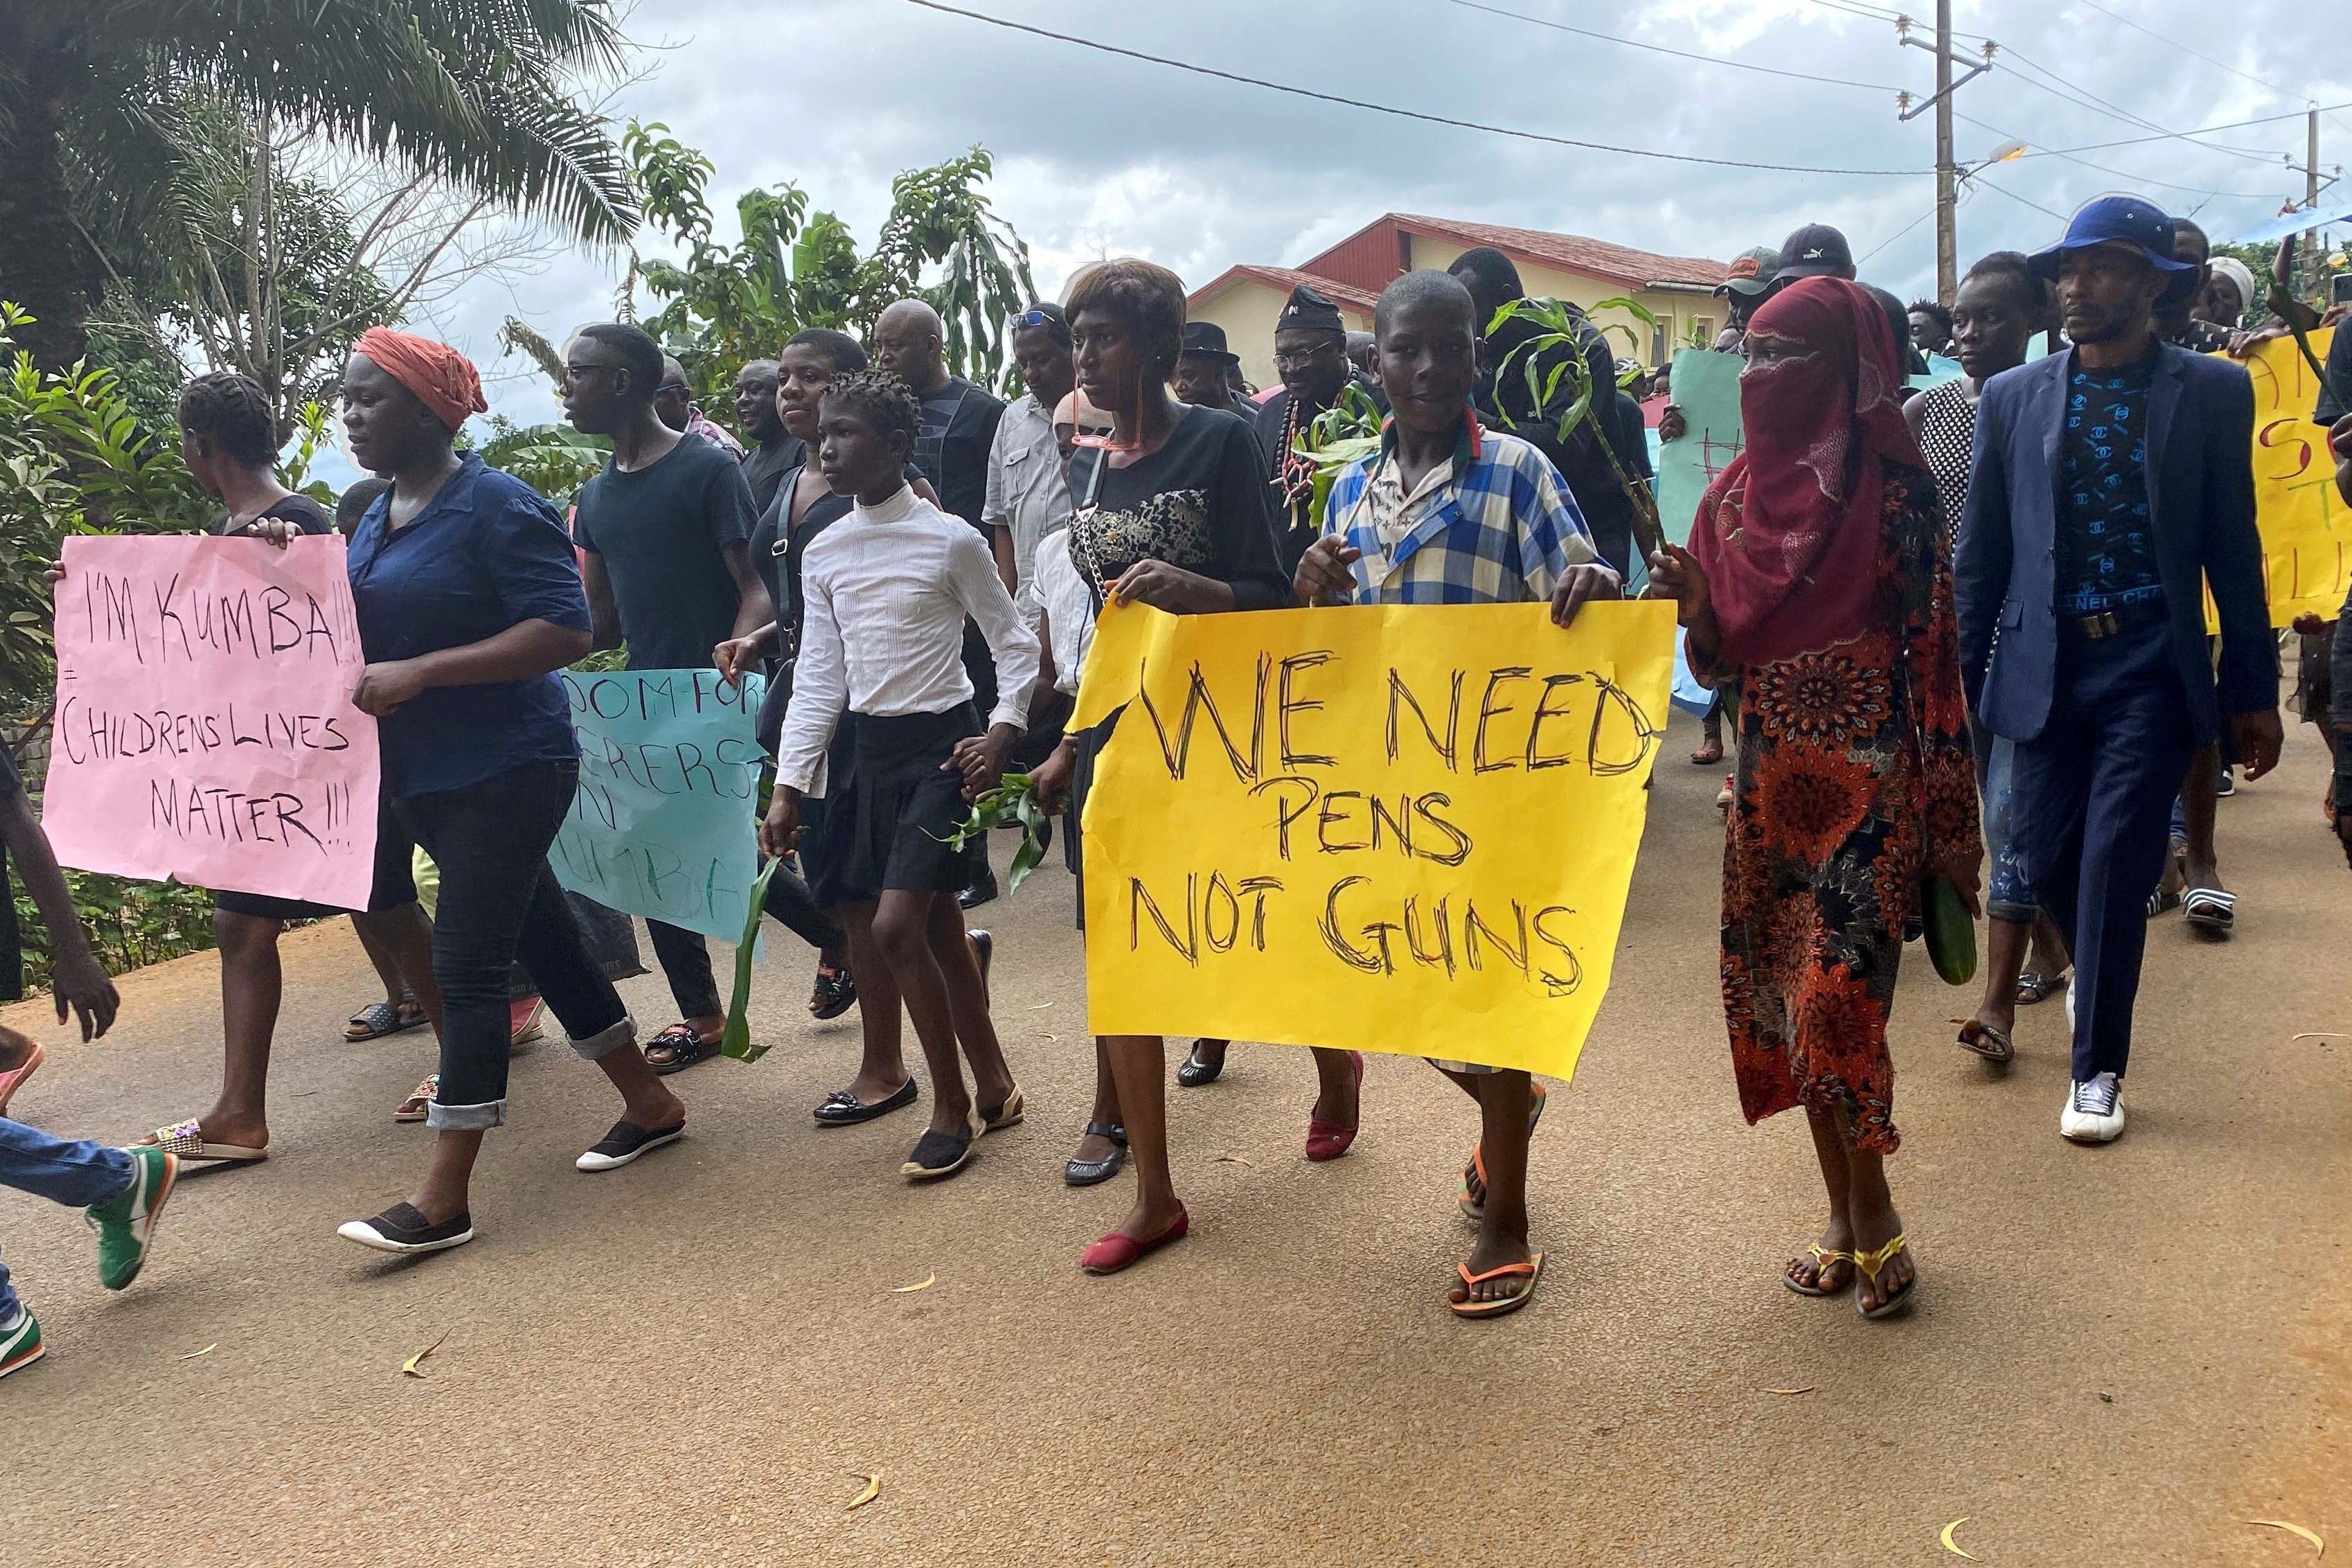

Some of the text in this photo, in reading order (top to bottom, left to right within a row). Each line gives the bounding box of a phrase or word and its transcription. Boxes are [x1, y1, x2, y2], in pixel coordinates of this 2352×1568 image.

[85, 570, 144, 665] I'M
[230, 702, 350, 753] LIVES
[693, 671, 759, 715] FOR
[1141, 648, 1655, 782] WE NEED
[1249, 776, 1475, 867] PENS
[1129, 870, 1584, 999] NOT GUNS
